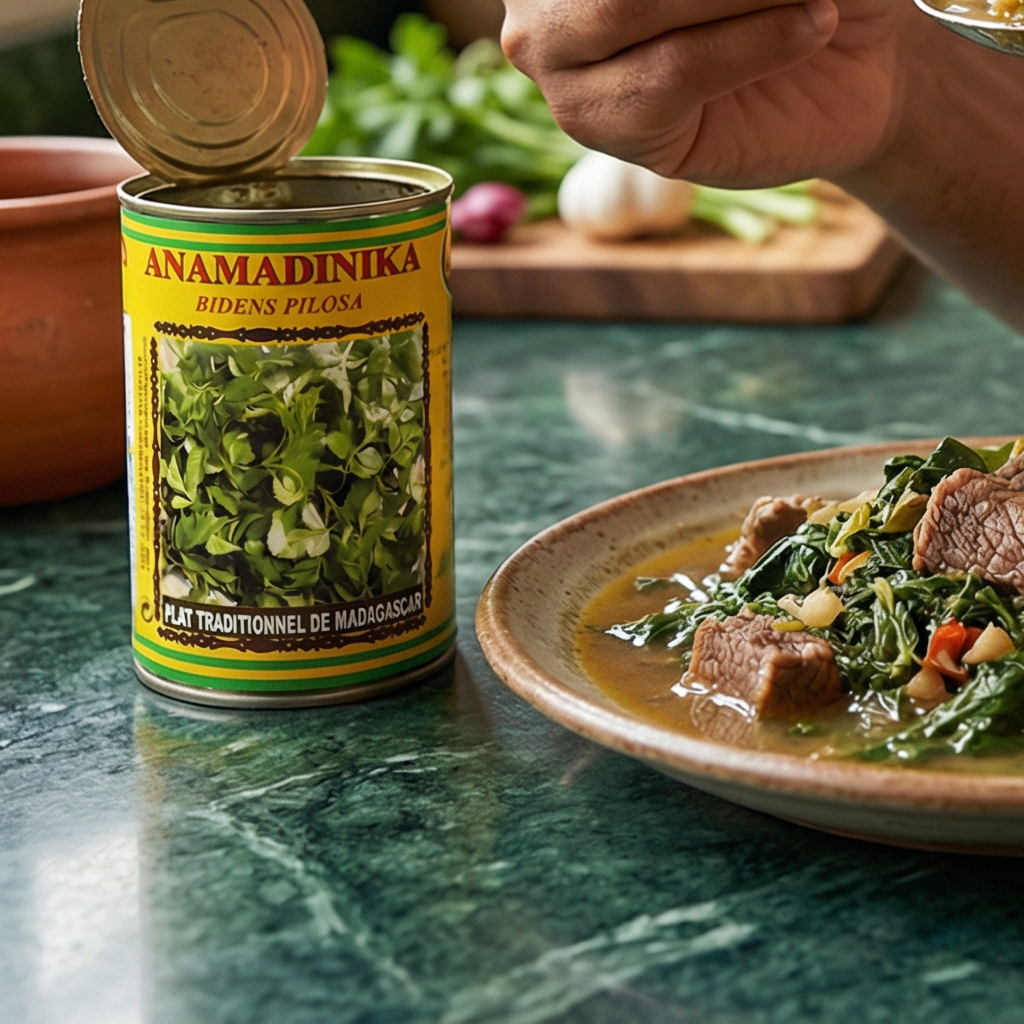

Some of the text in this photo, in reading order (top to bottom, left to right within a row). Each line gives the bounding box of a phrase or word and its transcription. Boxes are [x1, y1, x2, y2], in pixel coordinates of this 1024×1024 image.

[144, 242, 422, 286] ANAMADINIKA
[195, 292, 363, 316] BIDENS PILOSA
[164, 591, 422, 635] PLAT TRADITIONNEL DE MADAGASCAR
